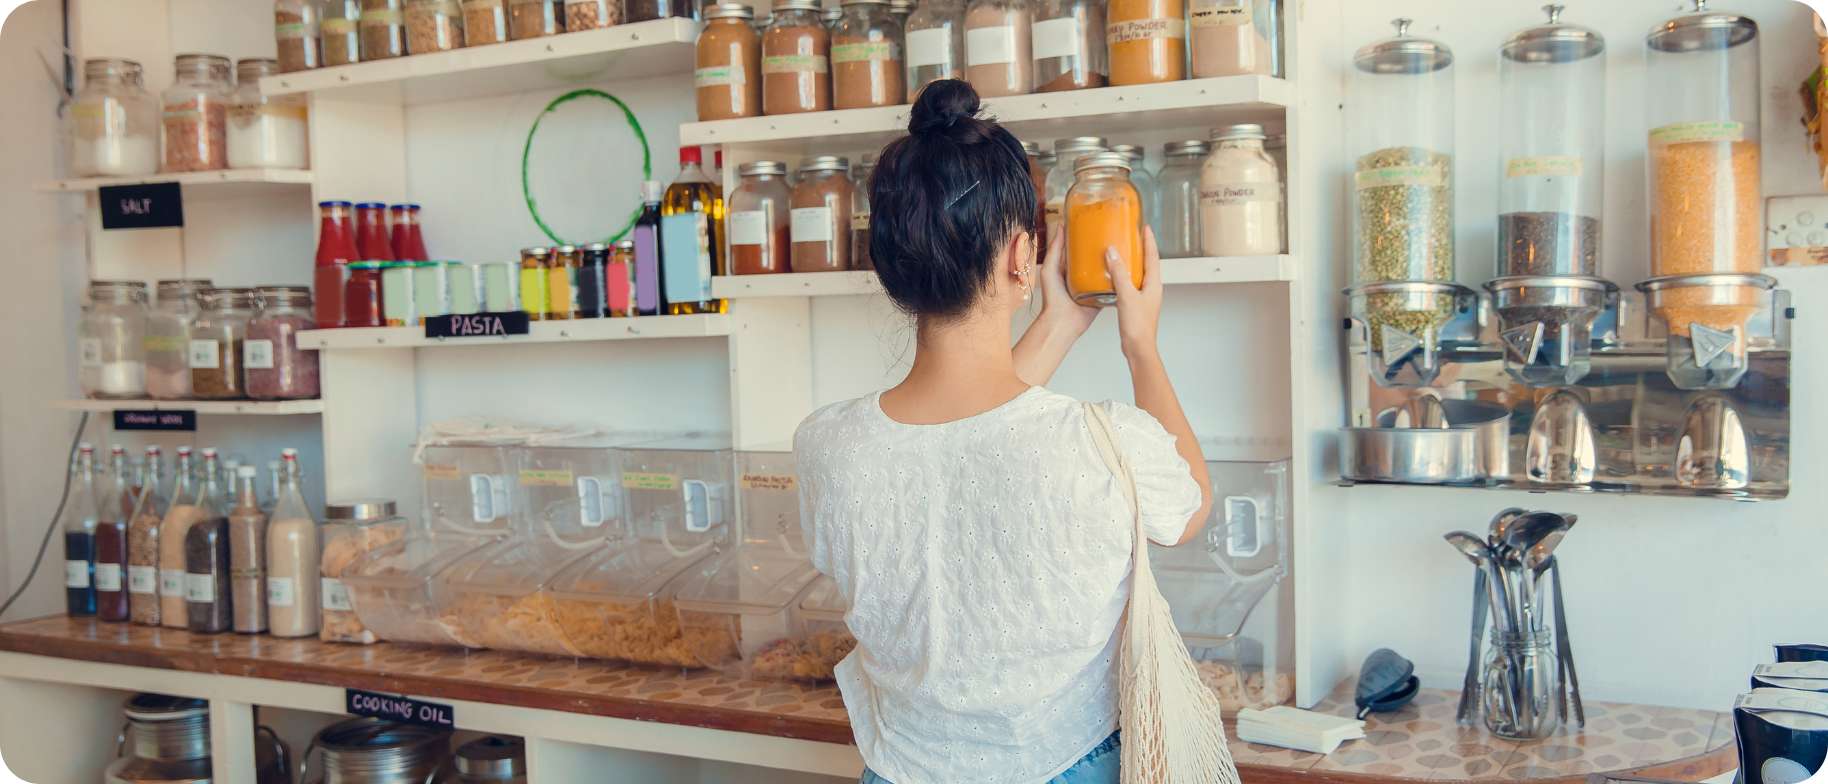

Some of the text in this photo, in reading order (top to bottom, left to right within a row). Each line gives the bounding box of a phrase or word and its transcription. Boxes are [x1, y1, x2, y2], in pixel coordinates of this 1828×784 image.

[1128, 21, 1168, 31] POWDER
[1223, 187, 1255, 197] POWDER
[120, 198, 151, 215] SALT
[450, 315, 508, 336] PASTA
[352, 694, 452, 724] COOKING OIL
